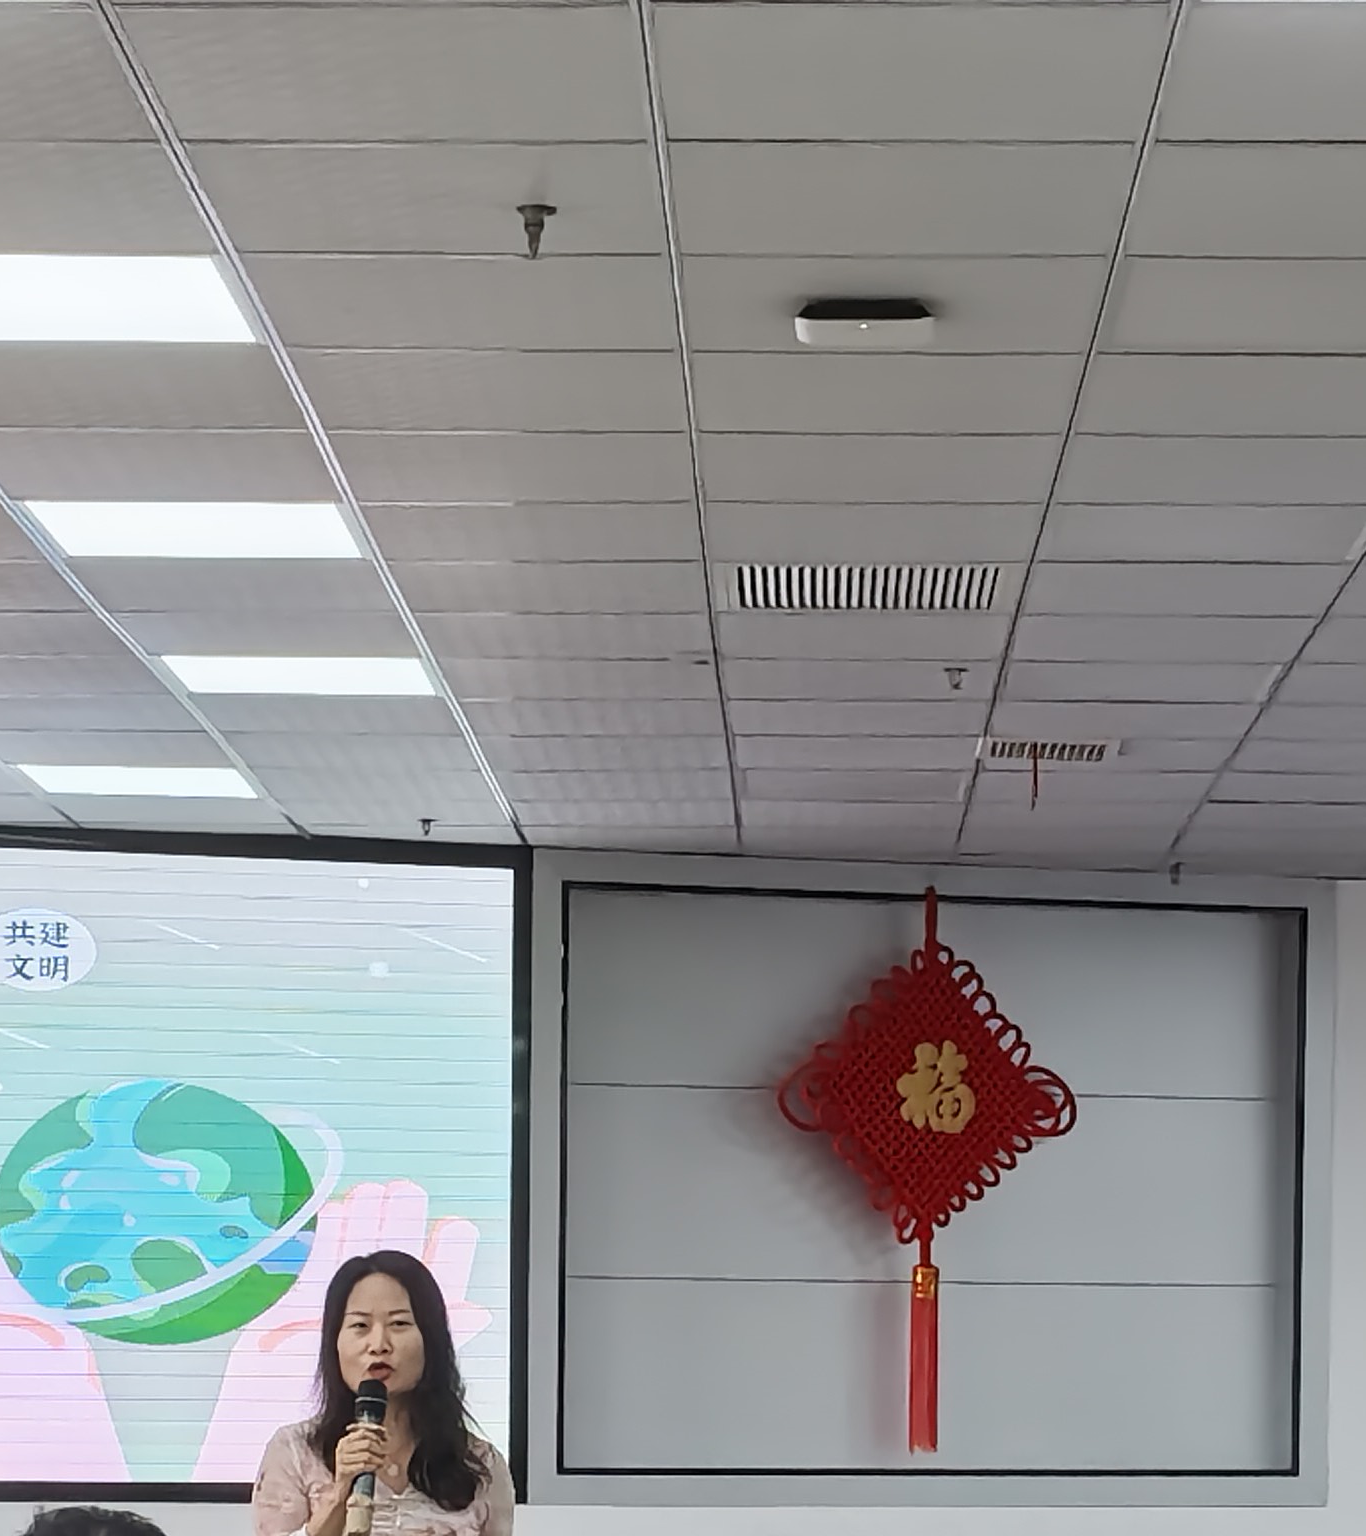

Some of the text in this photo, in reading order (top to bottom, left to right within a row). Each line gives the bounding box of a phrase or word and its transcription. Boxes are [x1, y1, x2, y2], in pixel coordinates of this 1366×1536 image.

[3, 920, 70, 949] 共建
[4, 953, 70, 982] 文明
[895, 1039, 977, 1135] 福
